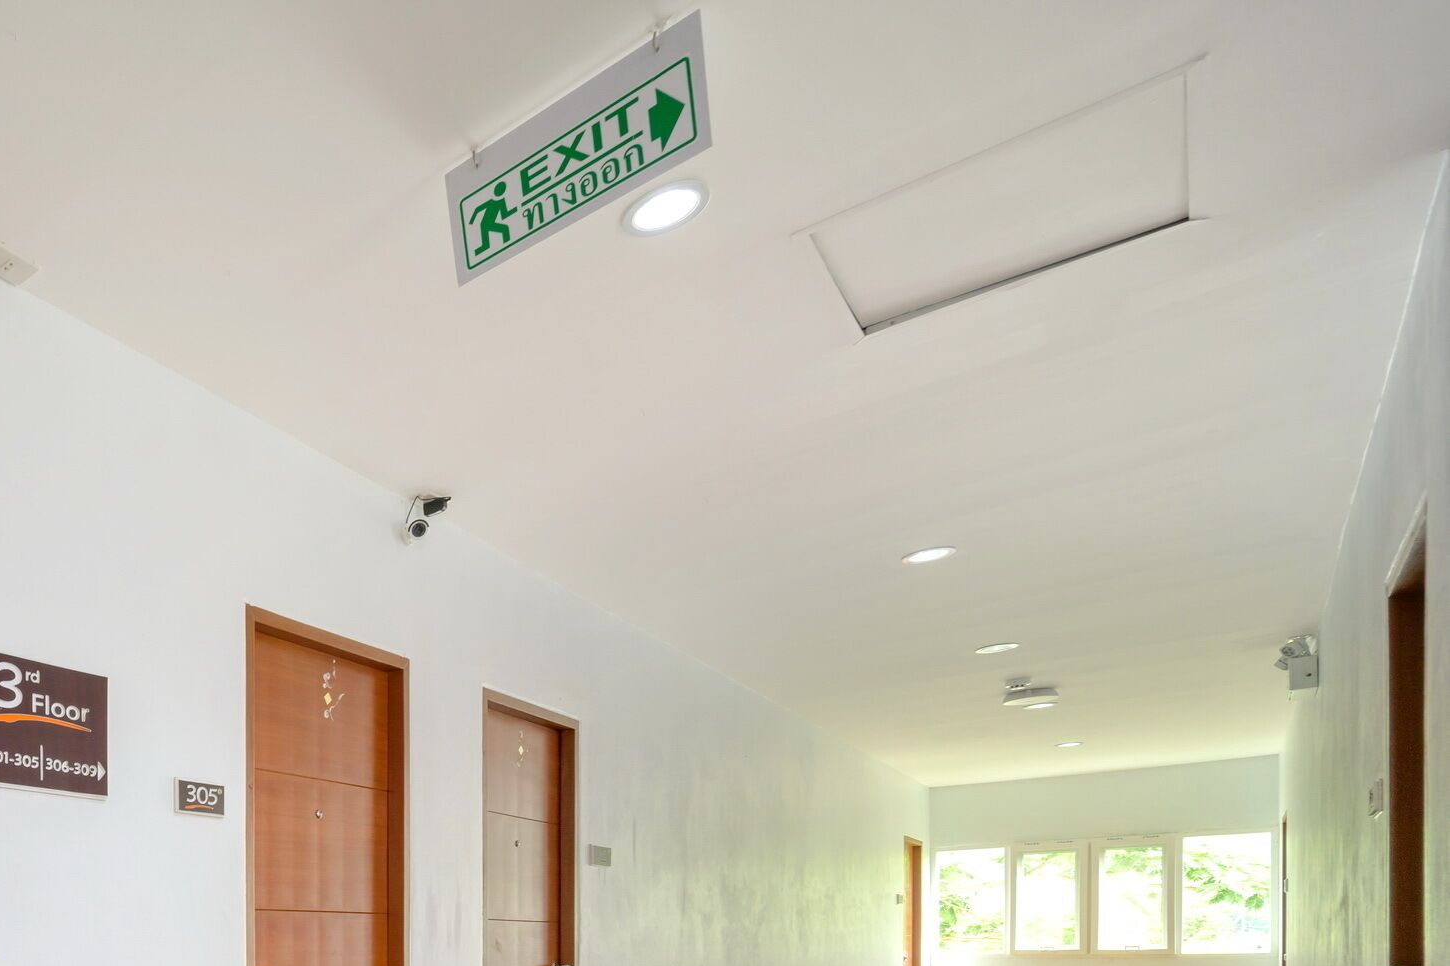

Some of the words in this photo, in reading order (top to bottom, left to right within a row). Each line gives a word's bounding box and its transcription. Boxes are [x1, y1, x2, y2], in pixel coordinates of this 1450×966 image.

[520, 96, 639, 198] EXIT
[522, 143, 645, 231] ทางออก
[31, 693, 90, 723] Floor
[45, 757, 98, 778] 306-309
[186, 784, 218, 805] 305
